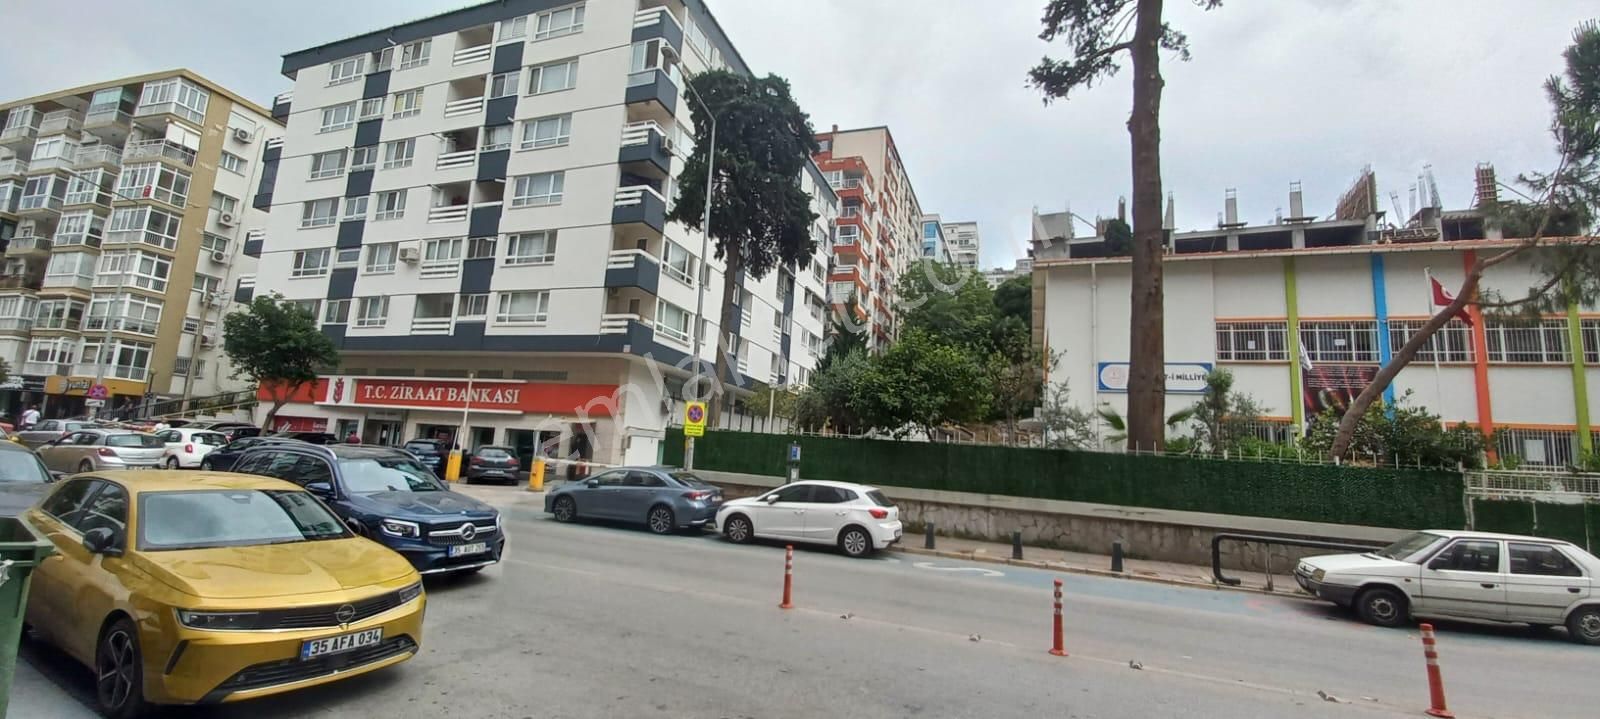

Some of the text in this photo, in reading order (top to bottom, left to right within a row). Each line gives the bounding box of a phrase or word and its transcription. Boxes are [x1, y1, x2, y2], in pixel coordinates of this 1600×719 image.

[364, 382, 520, 405] T.C. ZİRAAT BANKASI
[311, 629, 380, 655] 35 AFA 034
